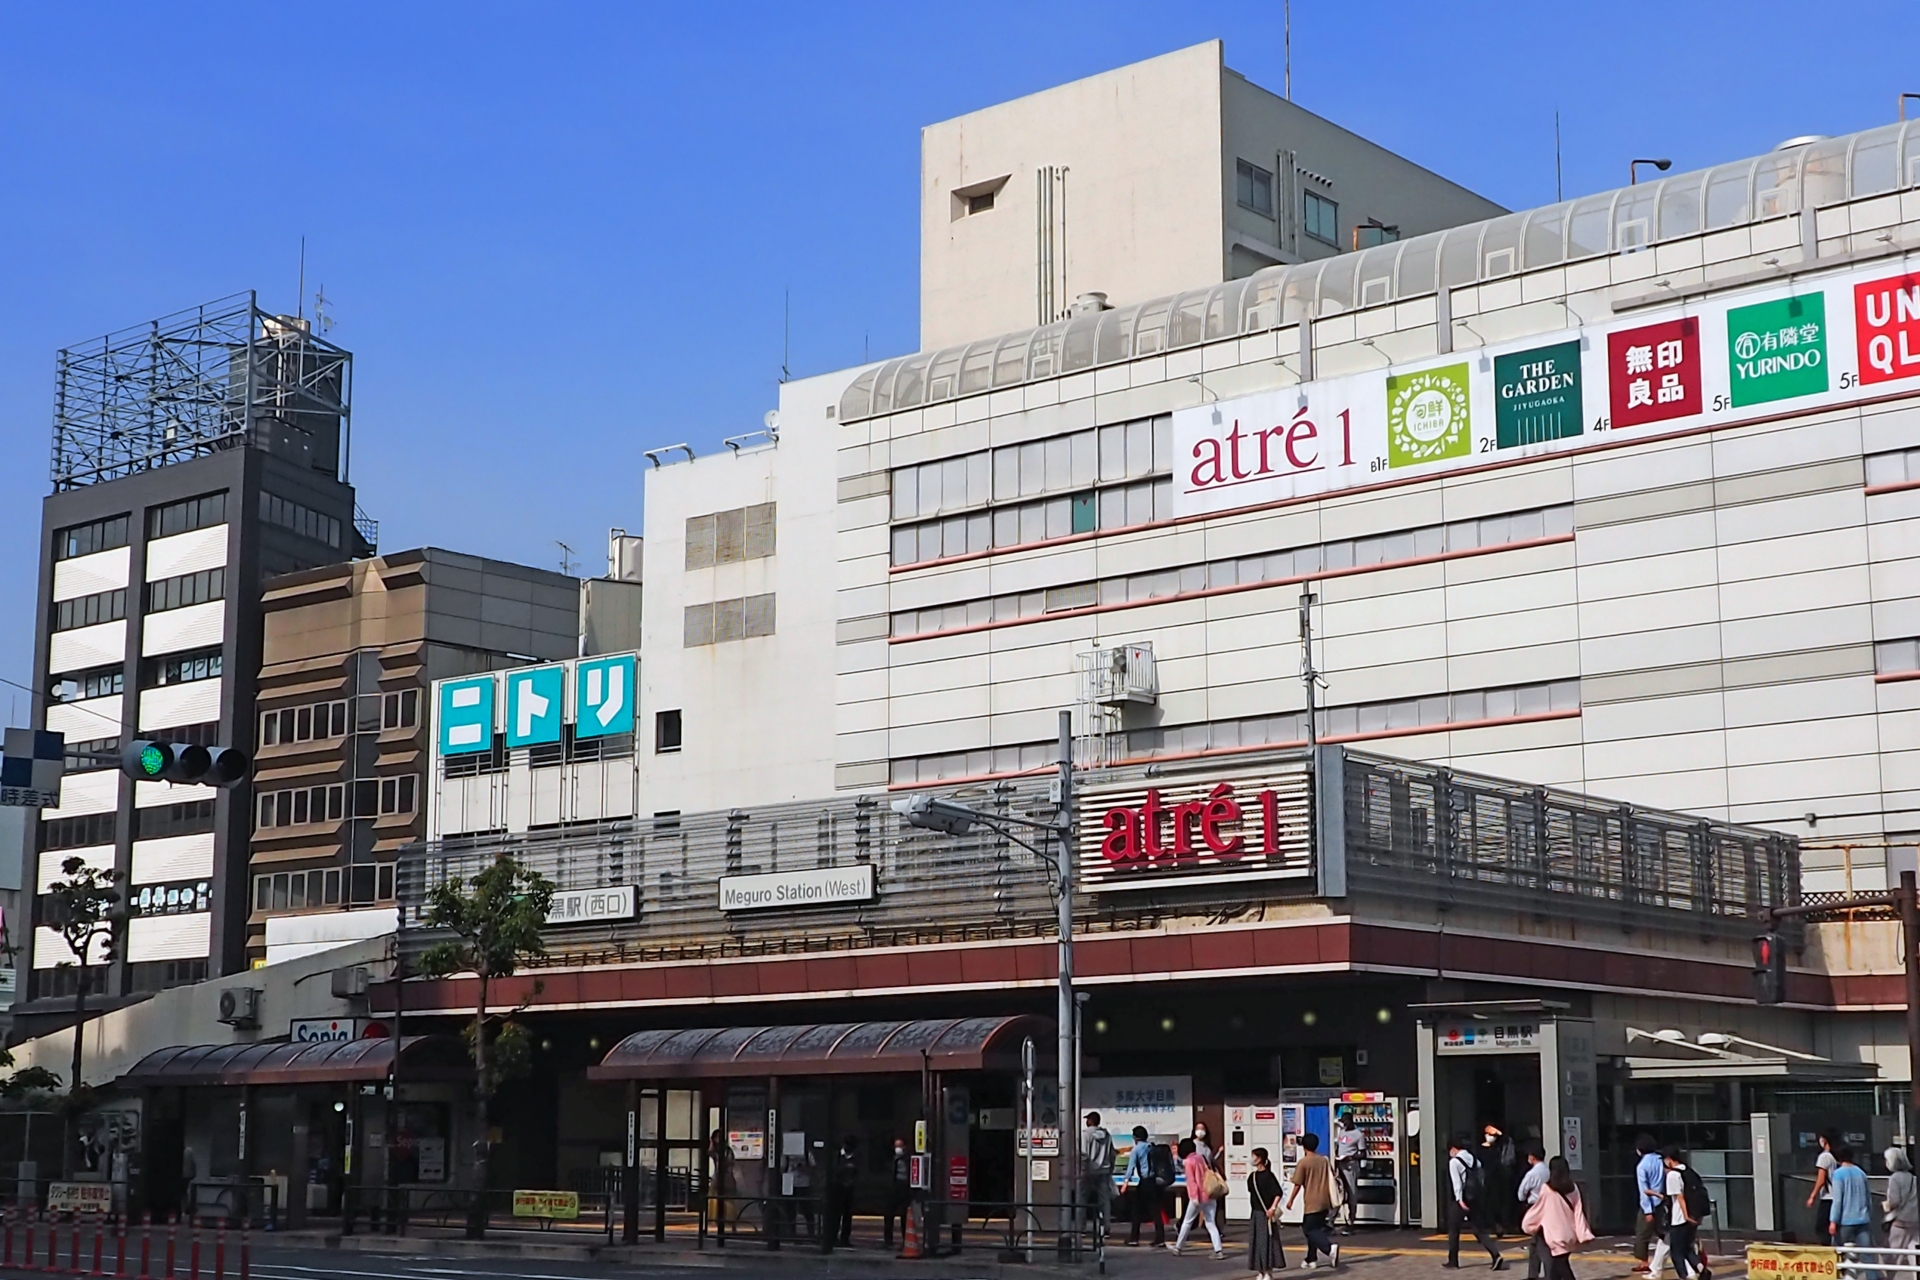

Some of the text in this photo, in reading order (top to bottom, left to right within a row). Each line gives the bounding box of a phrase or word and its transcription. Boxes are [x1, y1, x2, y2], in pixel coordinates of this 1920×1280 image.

[1760, 322, 1820, 352] 有隣堂
[1625, 339, 1683, 375] 無印
[1736, 349, 1821, 380] YURINDO
[1520, 359, 1556, 379] THE
[1839, 371, 1858, 390] 5F
[1501, 372, 1575, 399] GARDEN
[1627, 373, 1685, 409] 良品
[1513, 396, 1565, 412] JIYUGAOKA
[1712, 395, 1730, 412] 5F
[1413, 419, 1444, 432] ICHIBA
[1593, 416, 1610, 432] 4F
[1190, 406, 1357, 487] atré 1
[1480, 437, 1496, 454] 2F
[1370, 457, 1388, 473] B1F
[449, 664, 624, 746] ニトリ
[1, 788, 59, 808] 時差式
[1101, 782, 1280, 861] atré 1
[725, 877, 866, 906] Meguro Station (West)
